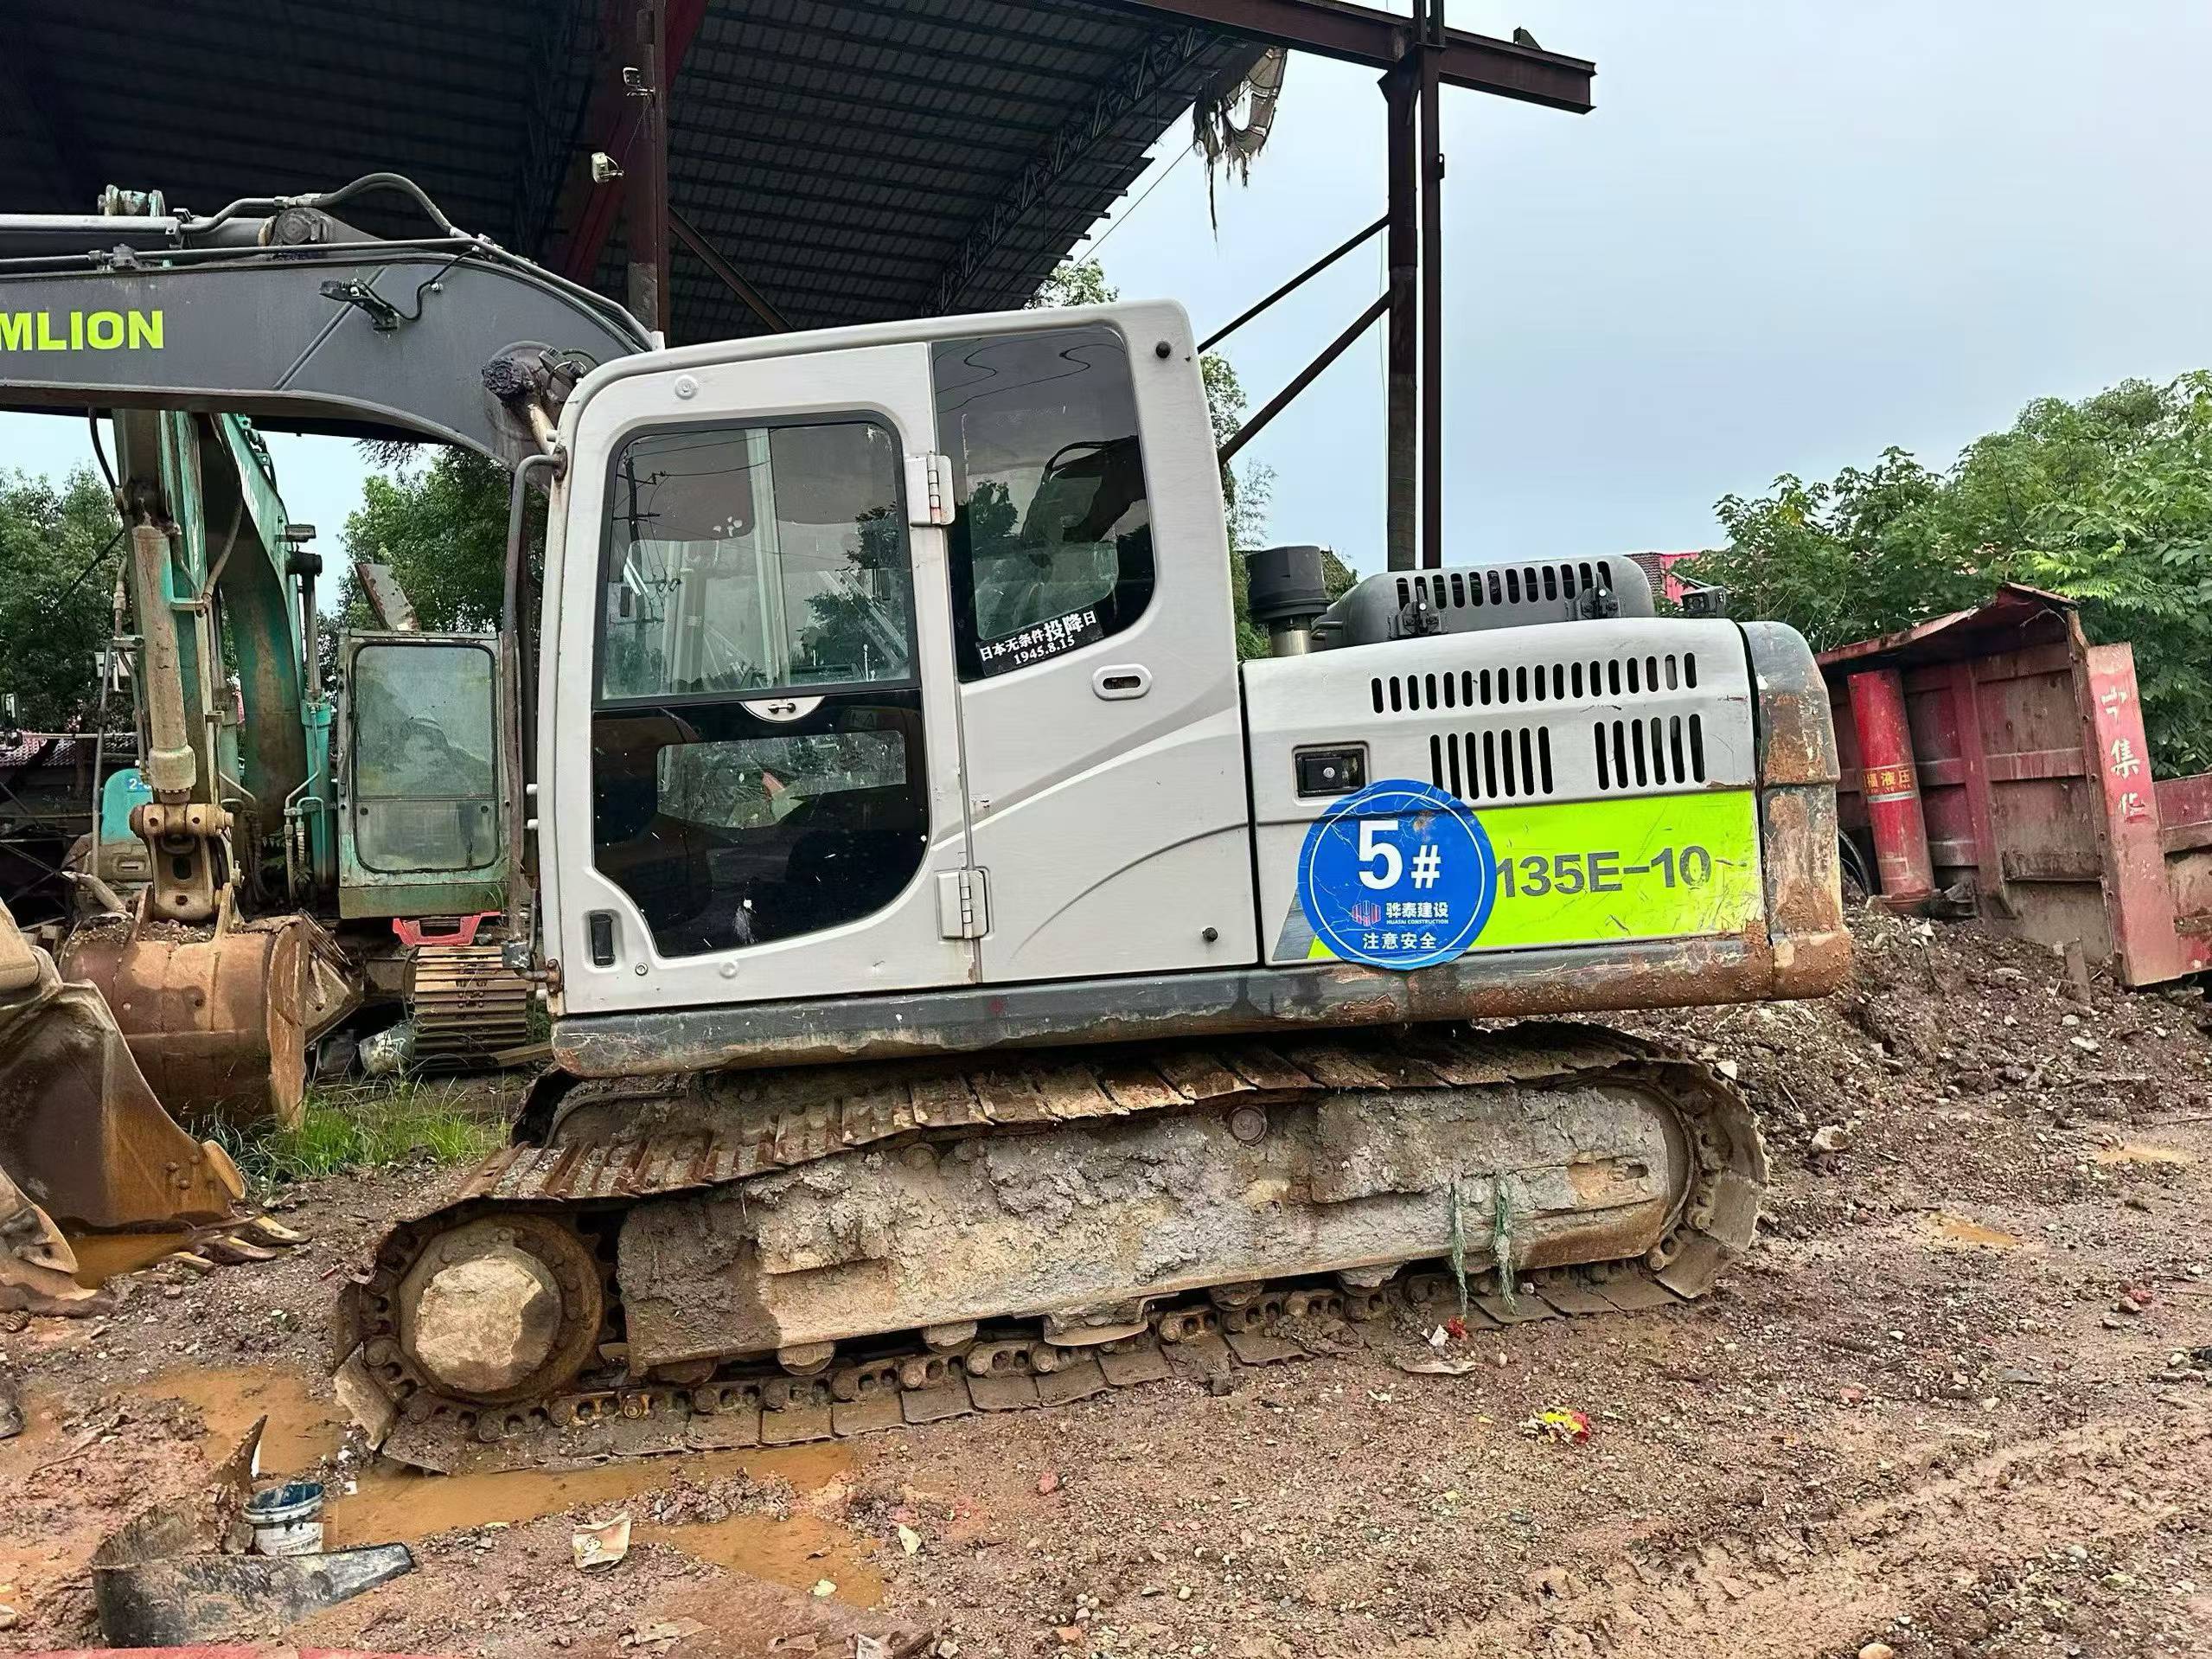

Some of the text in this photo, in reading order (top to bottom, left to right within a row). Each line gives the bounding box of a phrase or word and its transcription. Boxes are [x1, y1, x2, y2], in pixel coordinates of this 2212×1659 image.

[0, 310, 164, 351] MLION
[979, 611, 1096, 662] 日本无条件投降日
[1013, 637, 1075, 665] 1945.8.15
[1496, 845, 1712, 898] 135E-10
[1385, 901, 1449, 918] 骅泰建设
[1363, 932, 1437, 950] 注意安全
